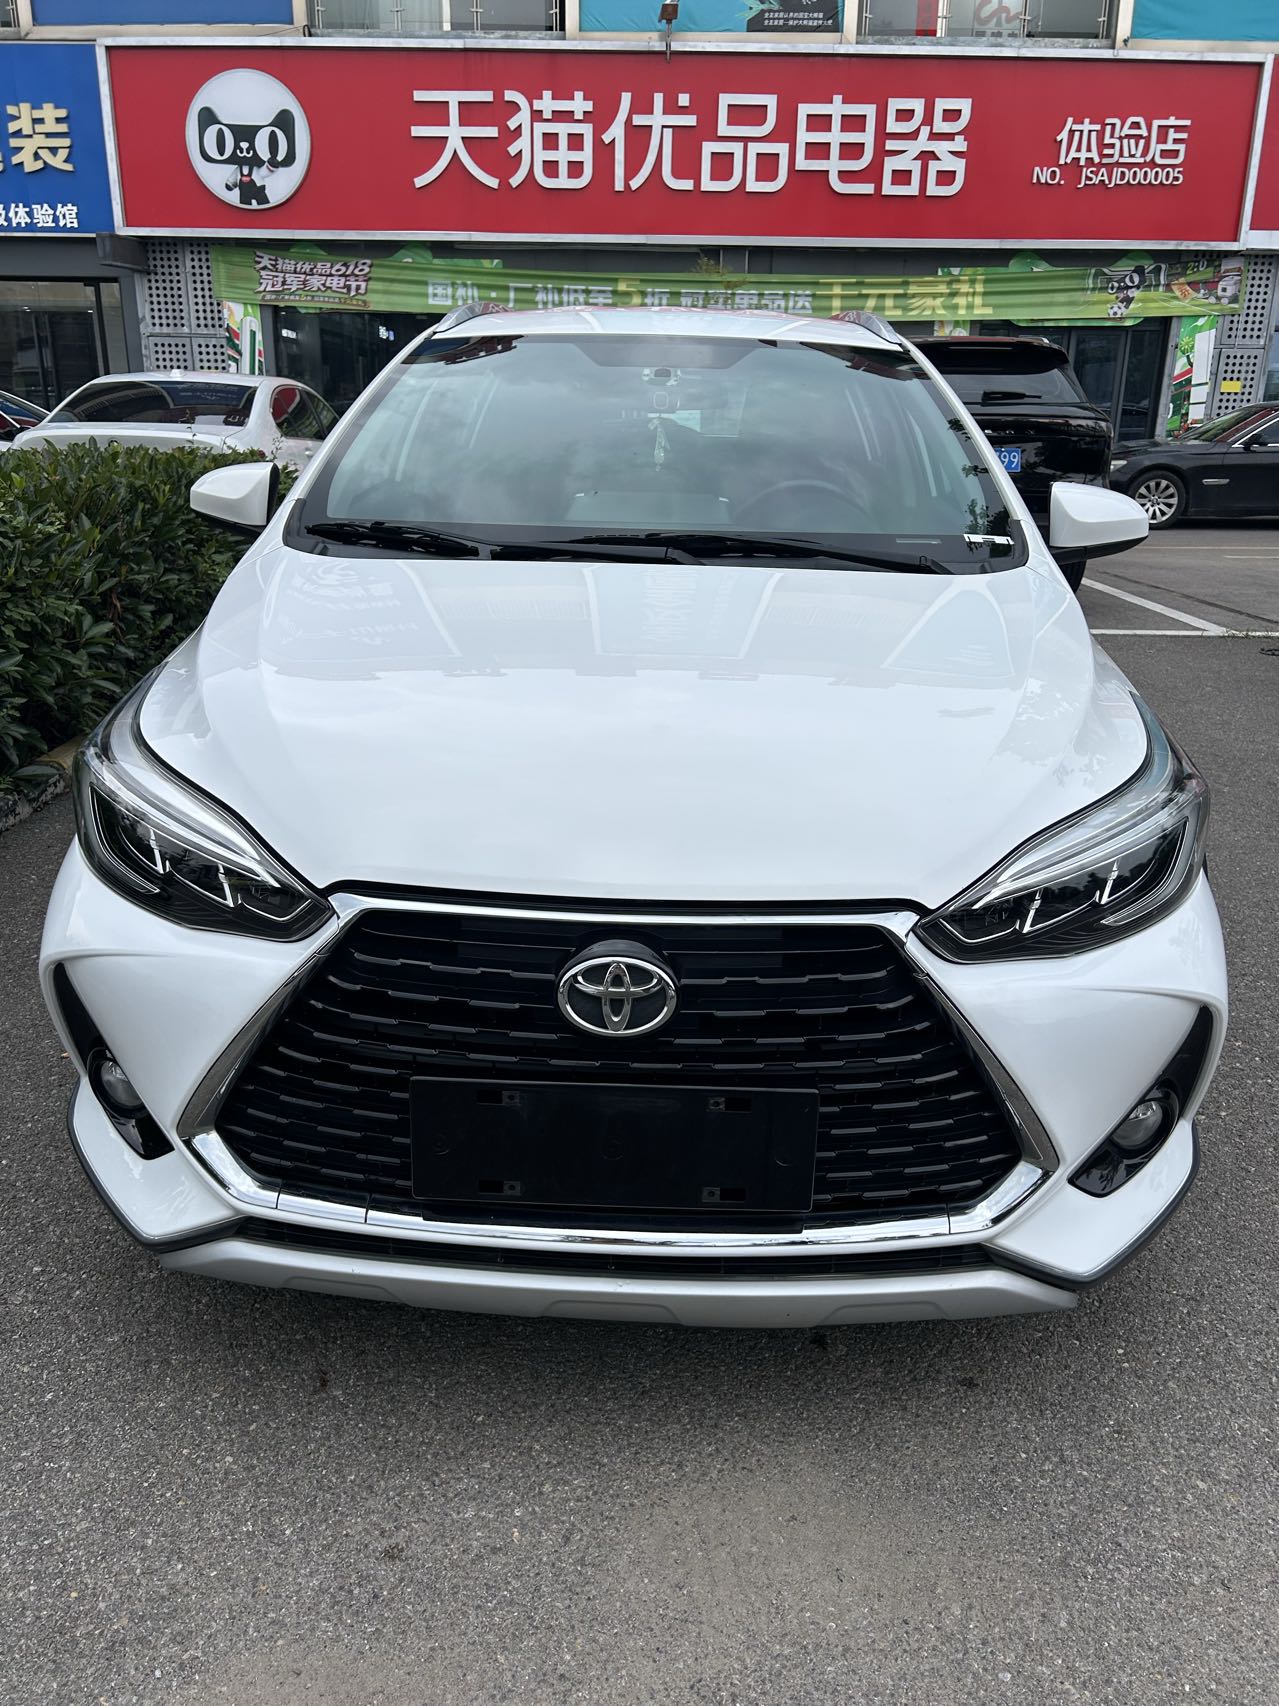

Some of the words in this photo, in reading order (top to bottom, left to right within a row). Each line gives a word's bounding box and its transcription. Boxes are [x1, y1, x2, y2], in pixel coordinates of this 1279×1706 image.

[0, 102, 75, 173] 装
[411, 90, 972, 197] 天猫优品电器
[1056, 116, 1191, 165] 体验店
[1032, 166, 1065, 185] NO.
[1077, 167, 1184, 188] JSAJD00005
[254, 251, 372, 275] 天猫优品618
[254, 270, 370, 297] 冠军家电节
[996, 452, 1019, 468] 99
